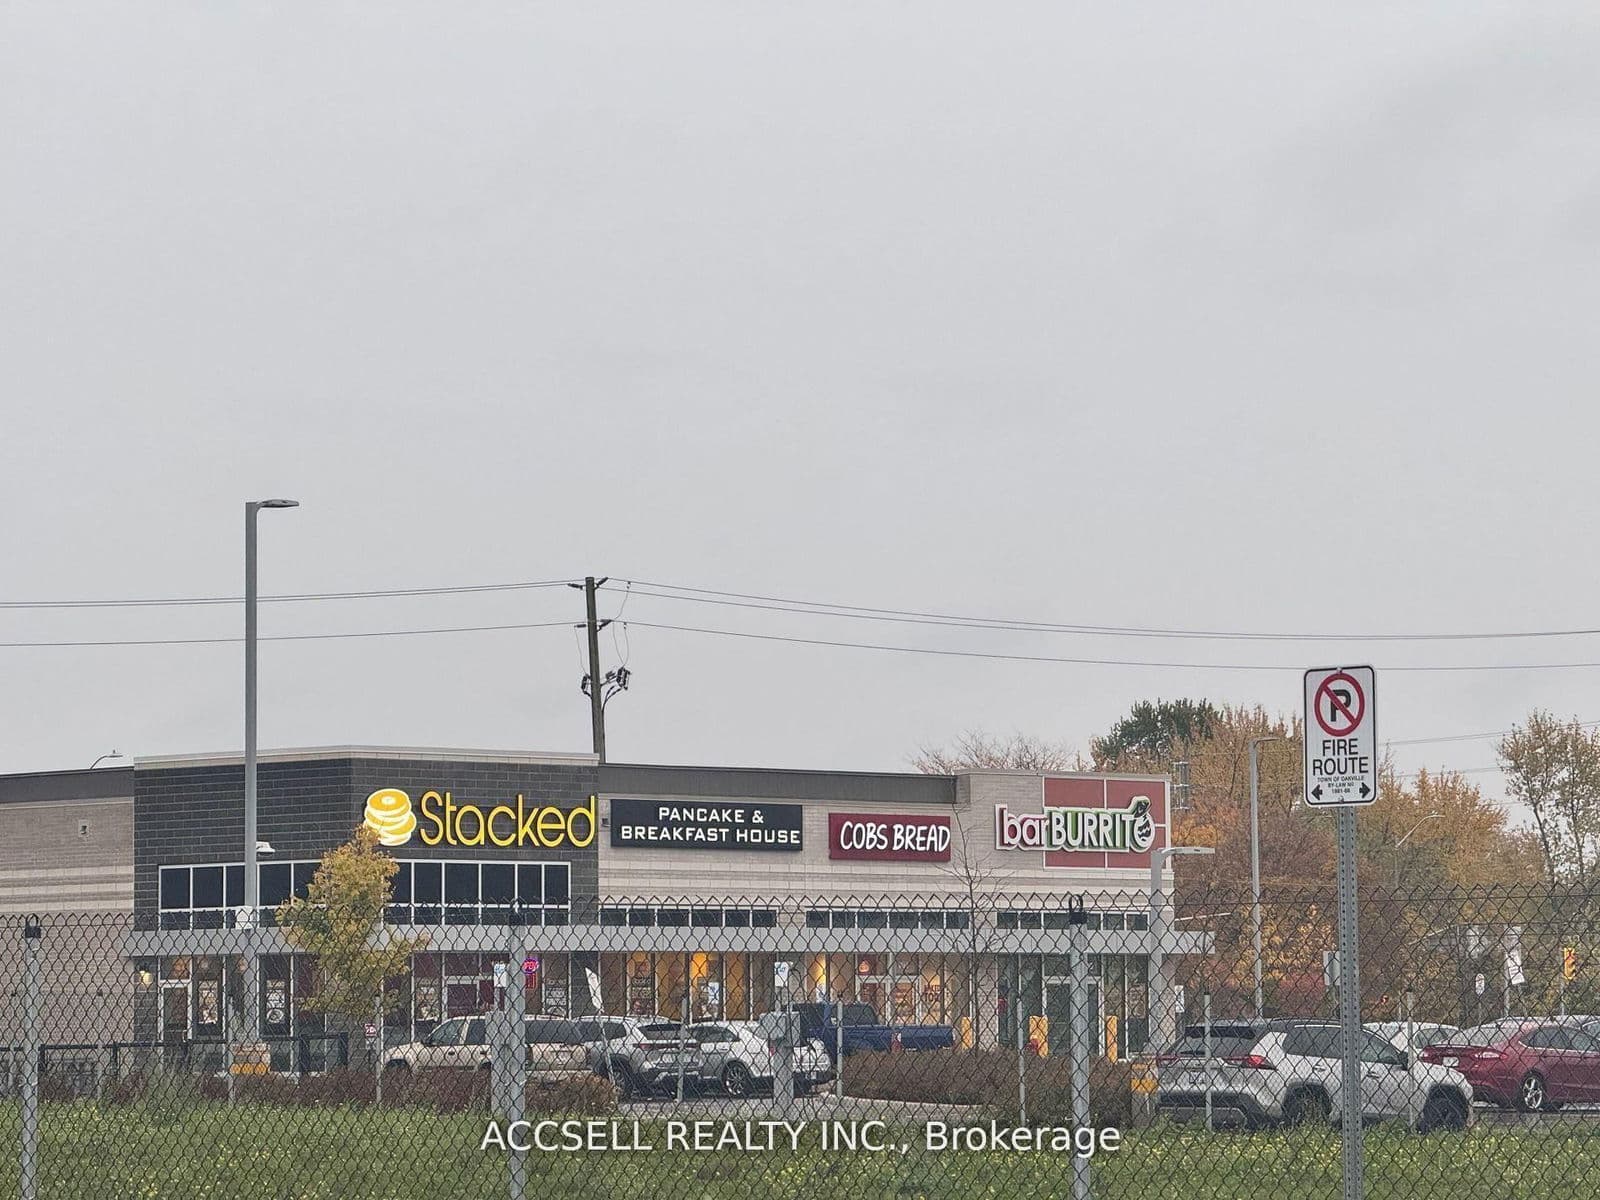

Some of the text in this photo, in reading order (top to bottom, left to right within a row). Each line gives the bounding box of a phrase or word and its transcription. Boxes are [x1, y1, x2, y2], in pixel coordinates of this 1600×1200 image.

[1322, 738, 1359, 757] FIRE
[1312, 756, 1369, 776] ROUTE
[420, 790, 596, 848] Stacked
[658, 806, 764, 824] PANCAKE &
[620, 825, 801, 844] BREAKFAST HOUSE
[840, 820, 951, 852] COBS BREAD
